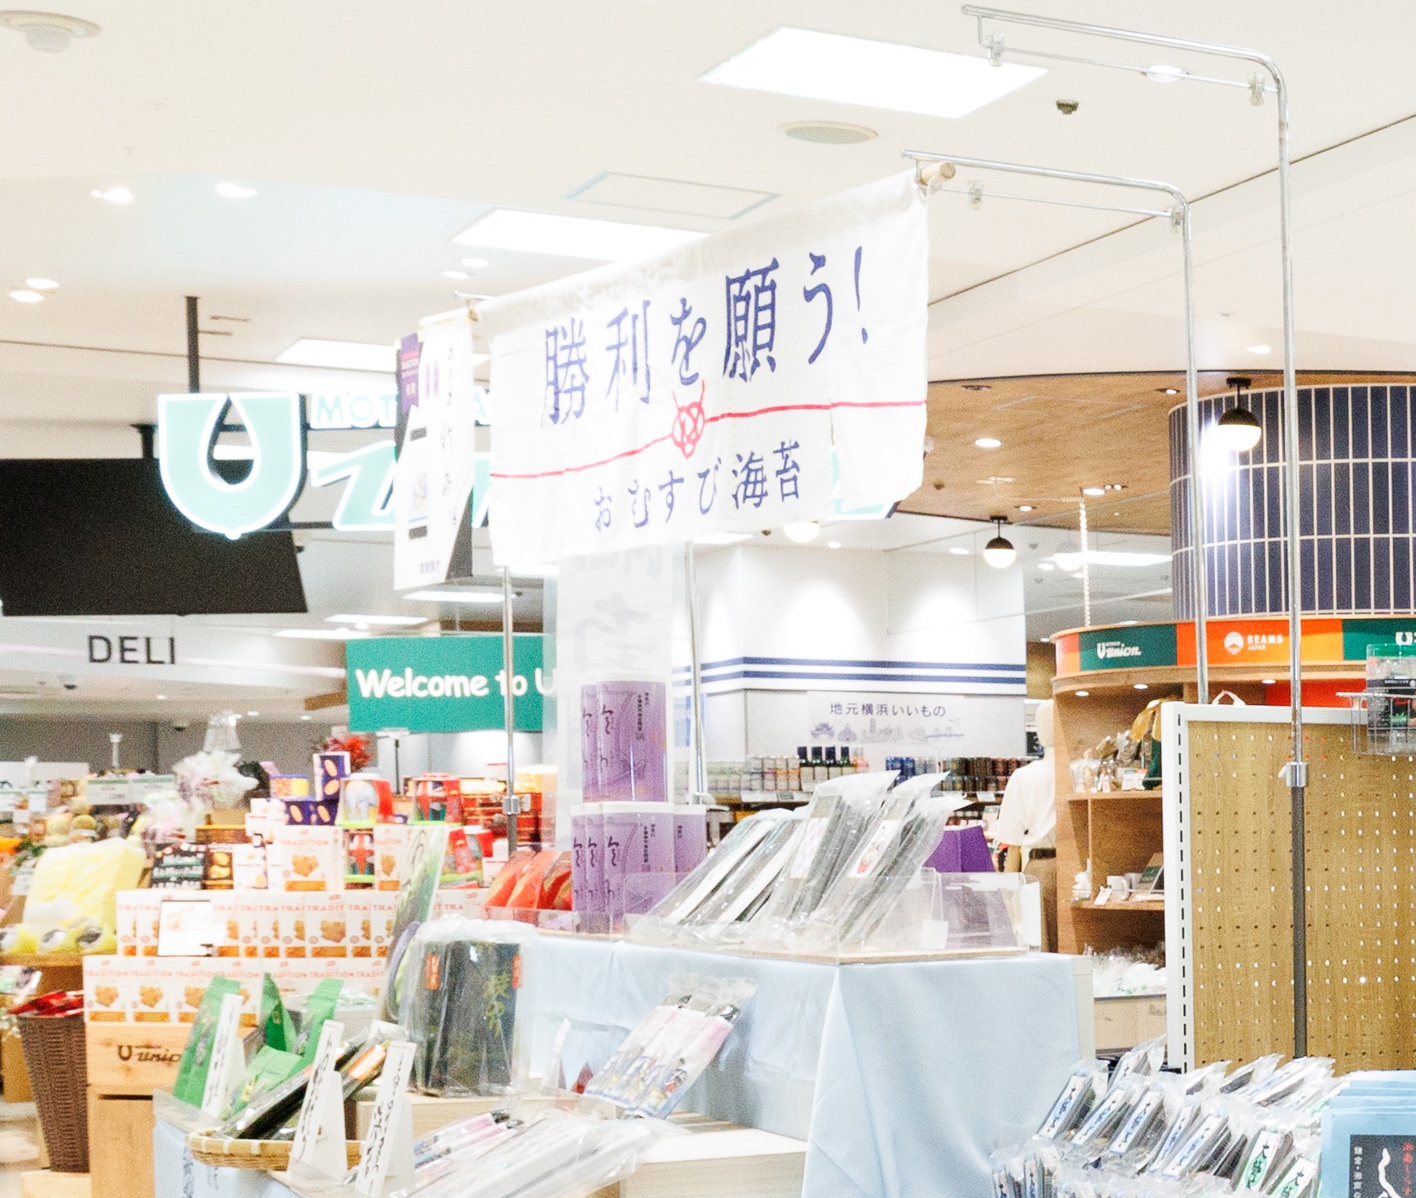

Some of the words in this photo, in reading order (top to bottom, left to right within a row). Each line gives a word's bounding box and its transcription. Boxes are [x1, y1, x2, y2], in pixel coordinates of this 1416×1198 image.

[544, 245, 869, 426] 勝利を願う！
[594, 440, 800, 533] おむすび海苔
[88, 635, 176, 666] DELI
[1247, 633, 1284, 645] BEAMS
[355, 667, 489, 700] Welcome
[830, 701, 946, 719] 地元横浜いいもの
